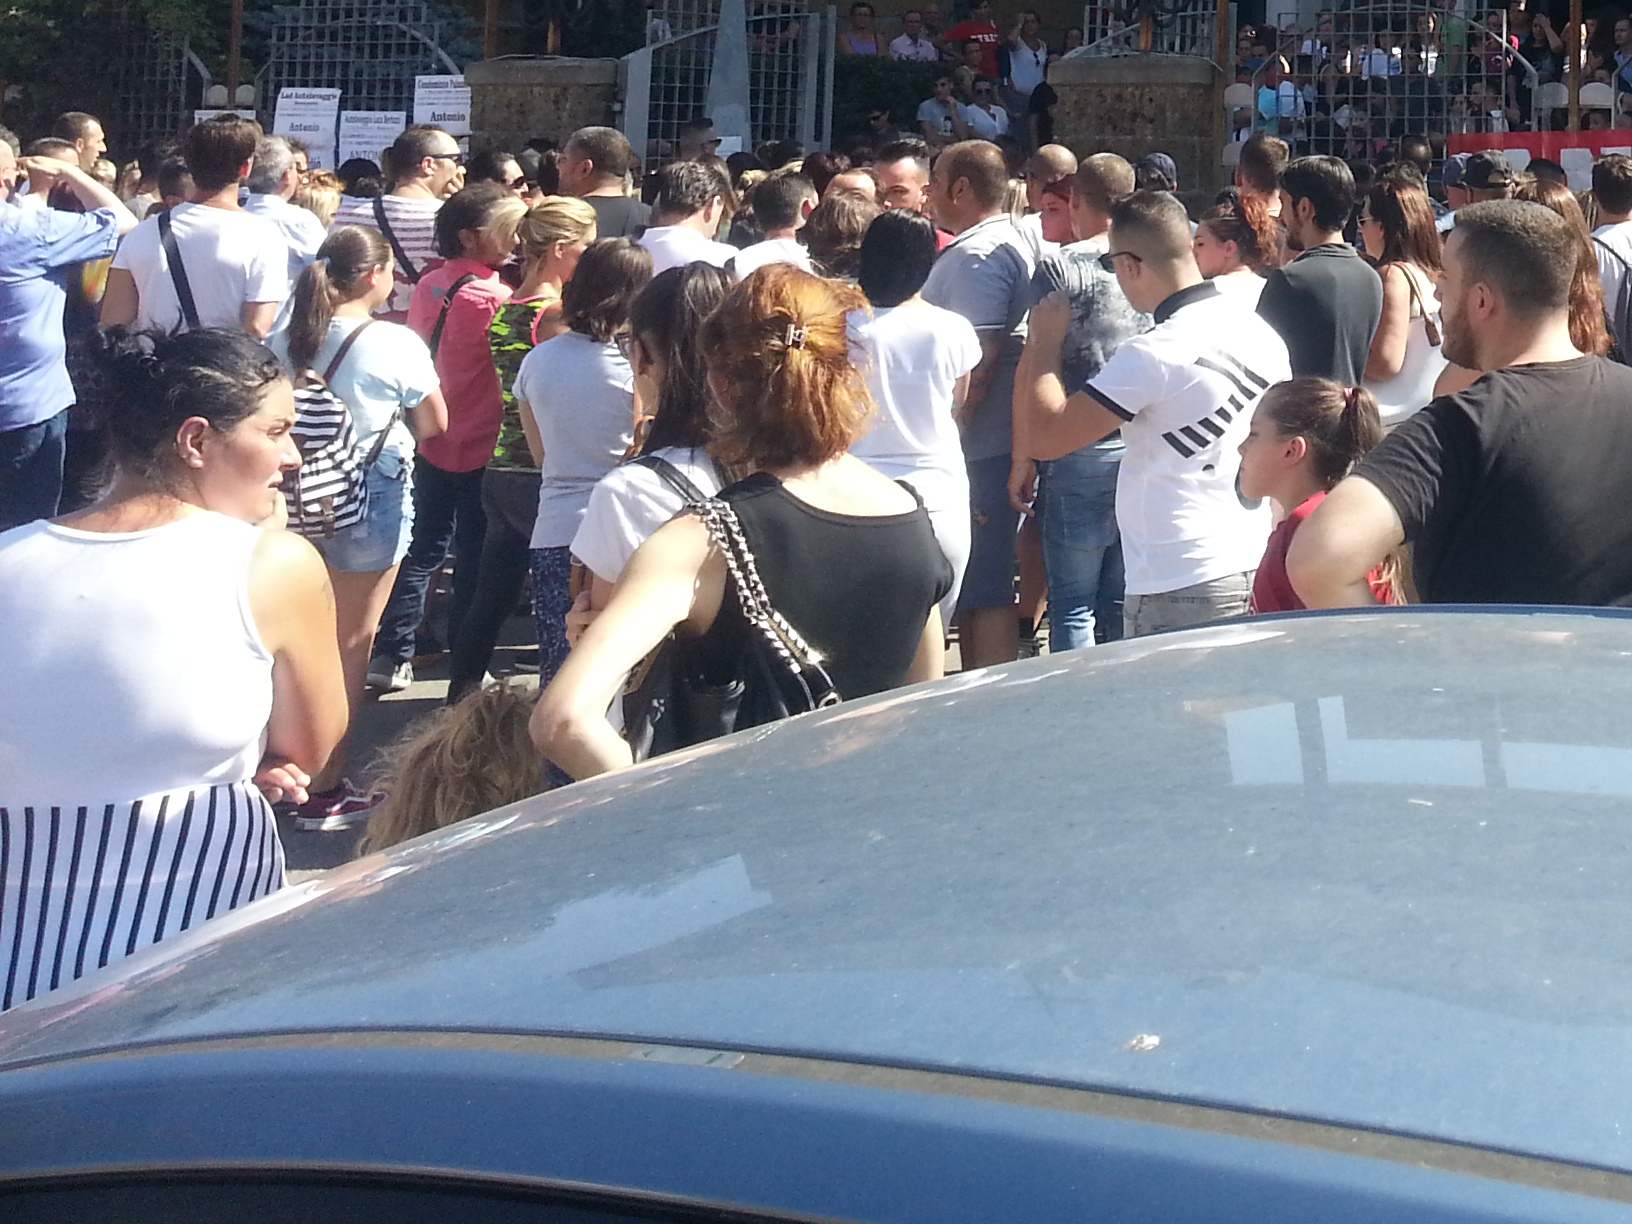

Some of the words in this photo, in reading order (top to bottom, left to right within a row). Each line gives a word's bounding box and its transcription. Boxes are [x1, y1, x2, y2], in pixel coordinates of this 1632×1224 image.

[430, 111, 466, 122] Antonio
[288, 122, 320, 132] Antonio
[350, 150, 383, 160] ANTON
